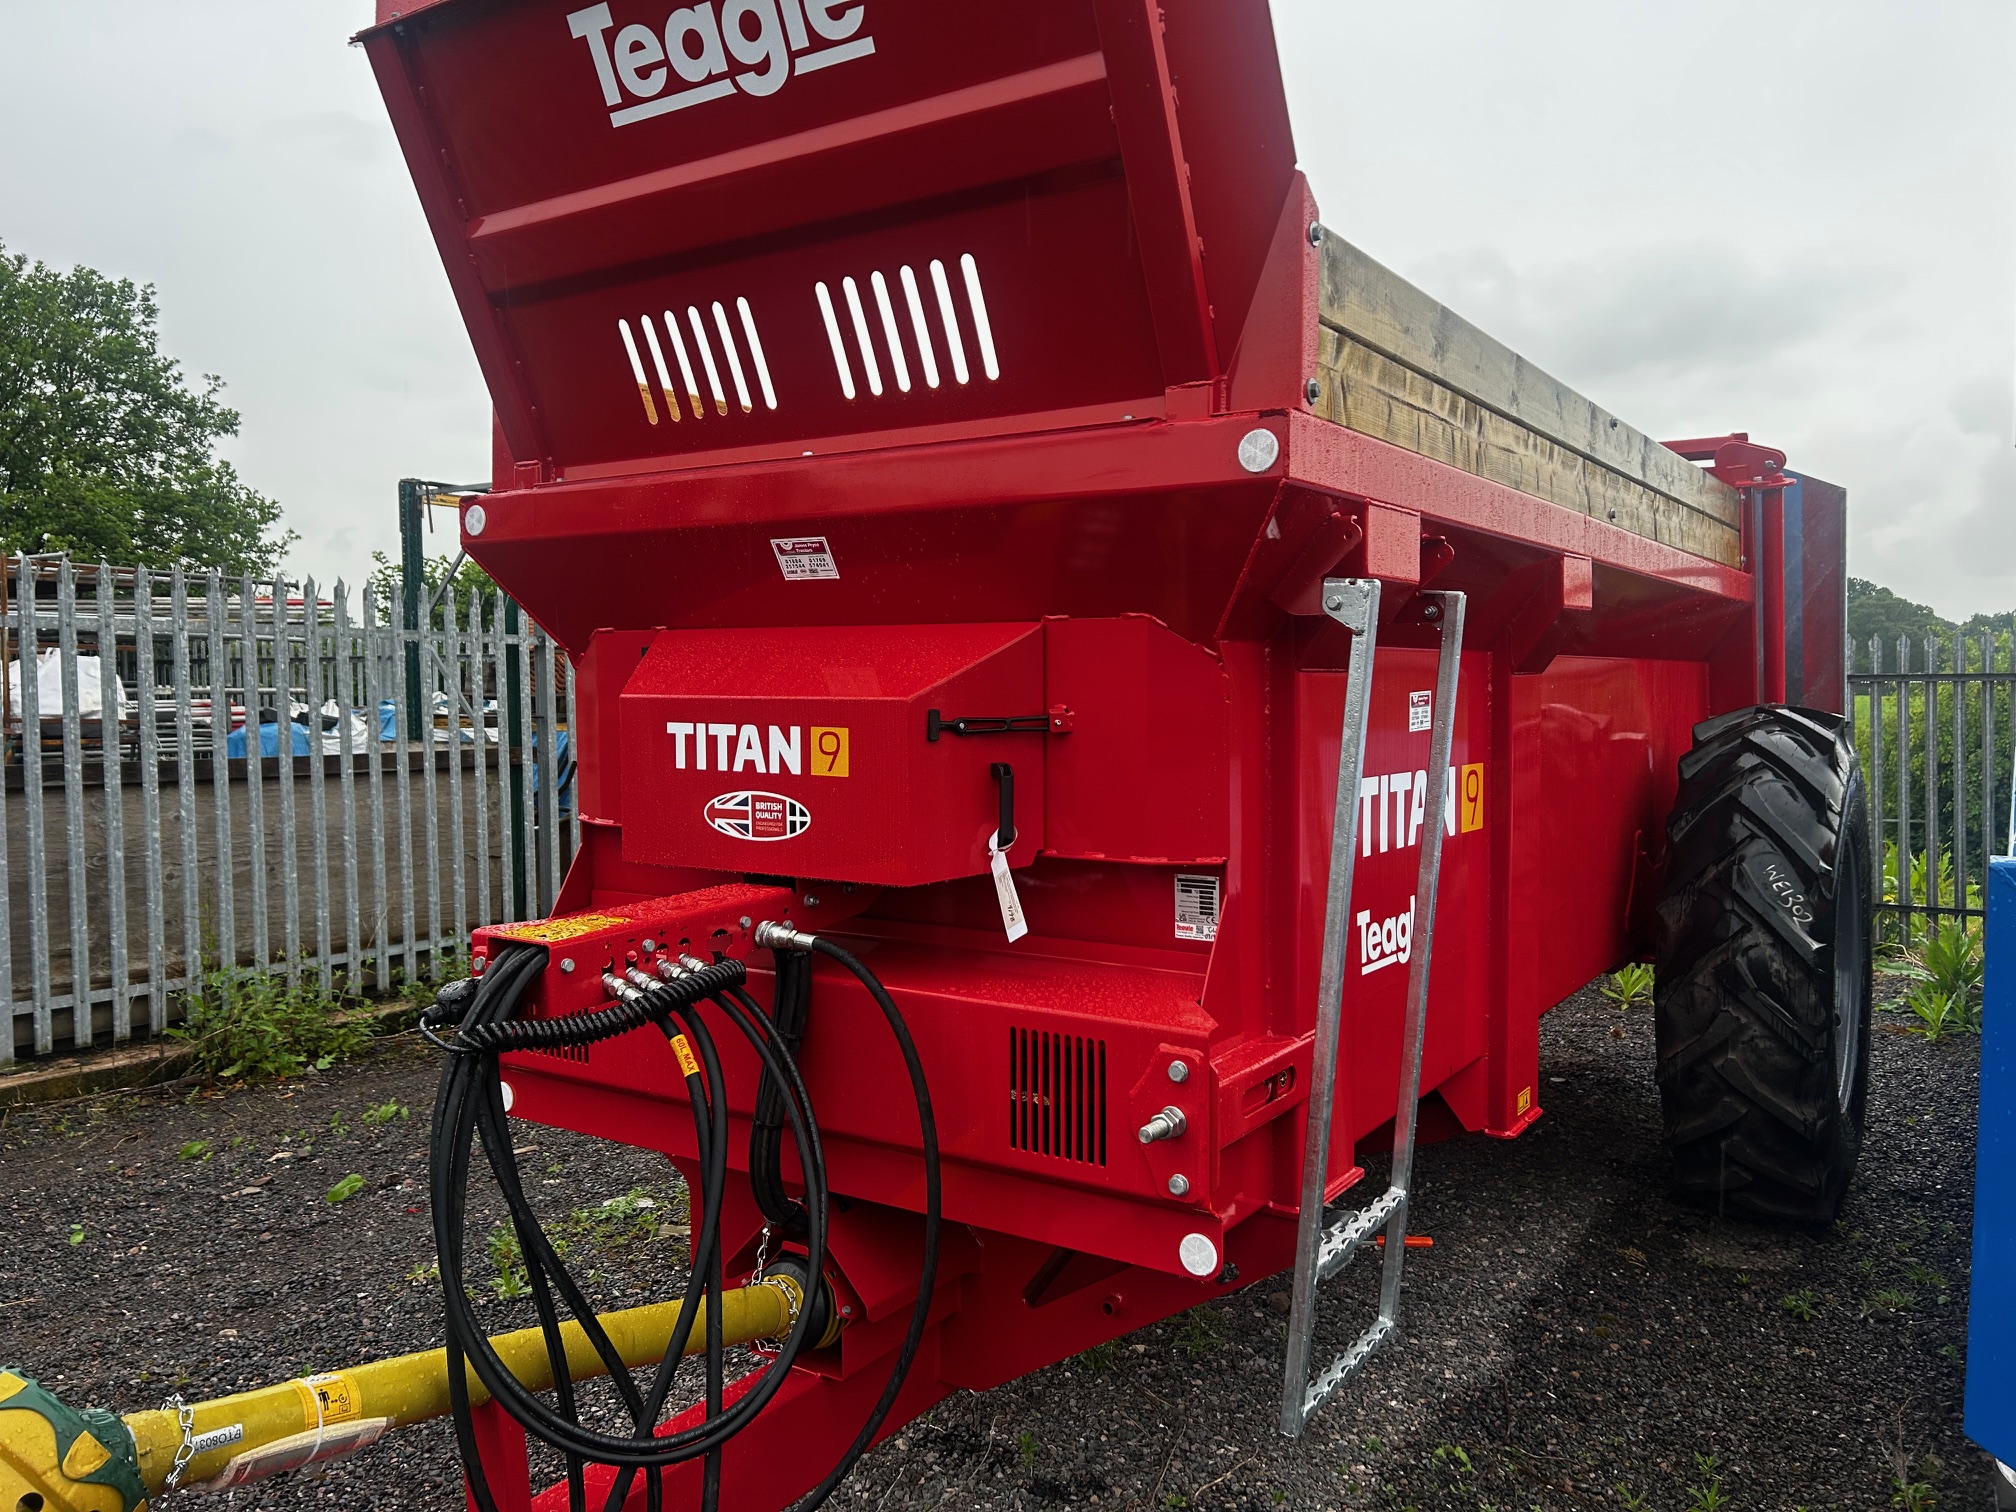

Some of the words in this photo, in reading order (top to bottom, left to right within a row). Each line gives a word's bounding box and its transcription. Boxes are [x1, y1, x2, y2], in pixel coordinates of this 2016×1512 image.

[666, 721, 802, 775] TITAN
[818, 731, 841, 772] 9
[755, 801, 783, 811] BRITISH
[755, 811, 783, 820] QUALITY
[1466, 769, 1479, 826] 9
[1357, 894, 1416, 964] Teagl
[676, 1037, 687, 1053] 60L
[683, 1053, 695, 1072] MAX
